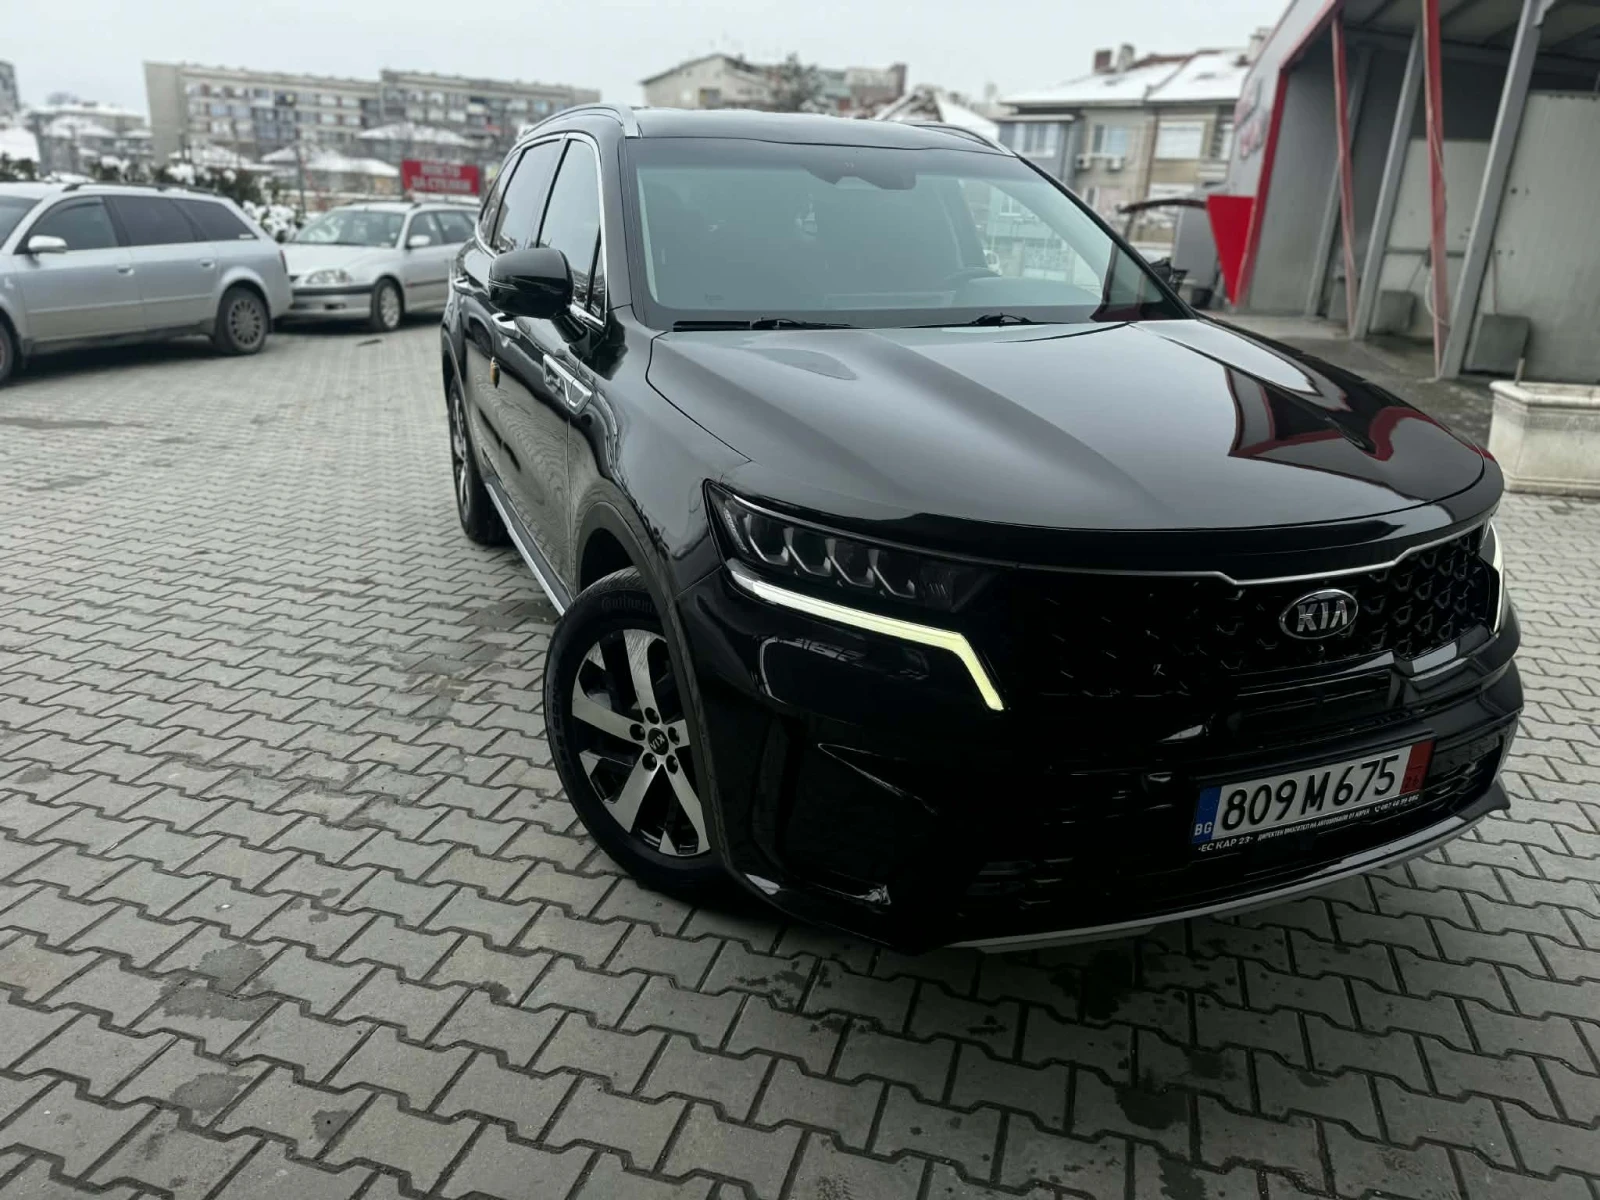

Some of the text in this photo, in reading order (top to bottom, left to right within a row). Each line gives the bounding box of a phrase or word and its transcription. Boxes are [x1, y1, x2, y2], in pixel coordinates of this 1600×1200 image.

[1297, 600, 1347, 631] KIA
[650, 734, 665, 750] KIA
[1221, 754, 1399, 830] 809 M 675
[1194, 822, 1212, 836] BG
